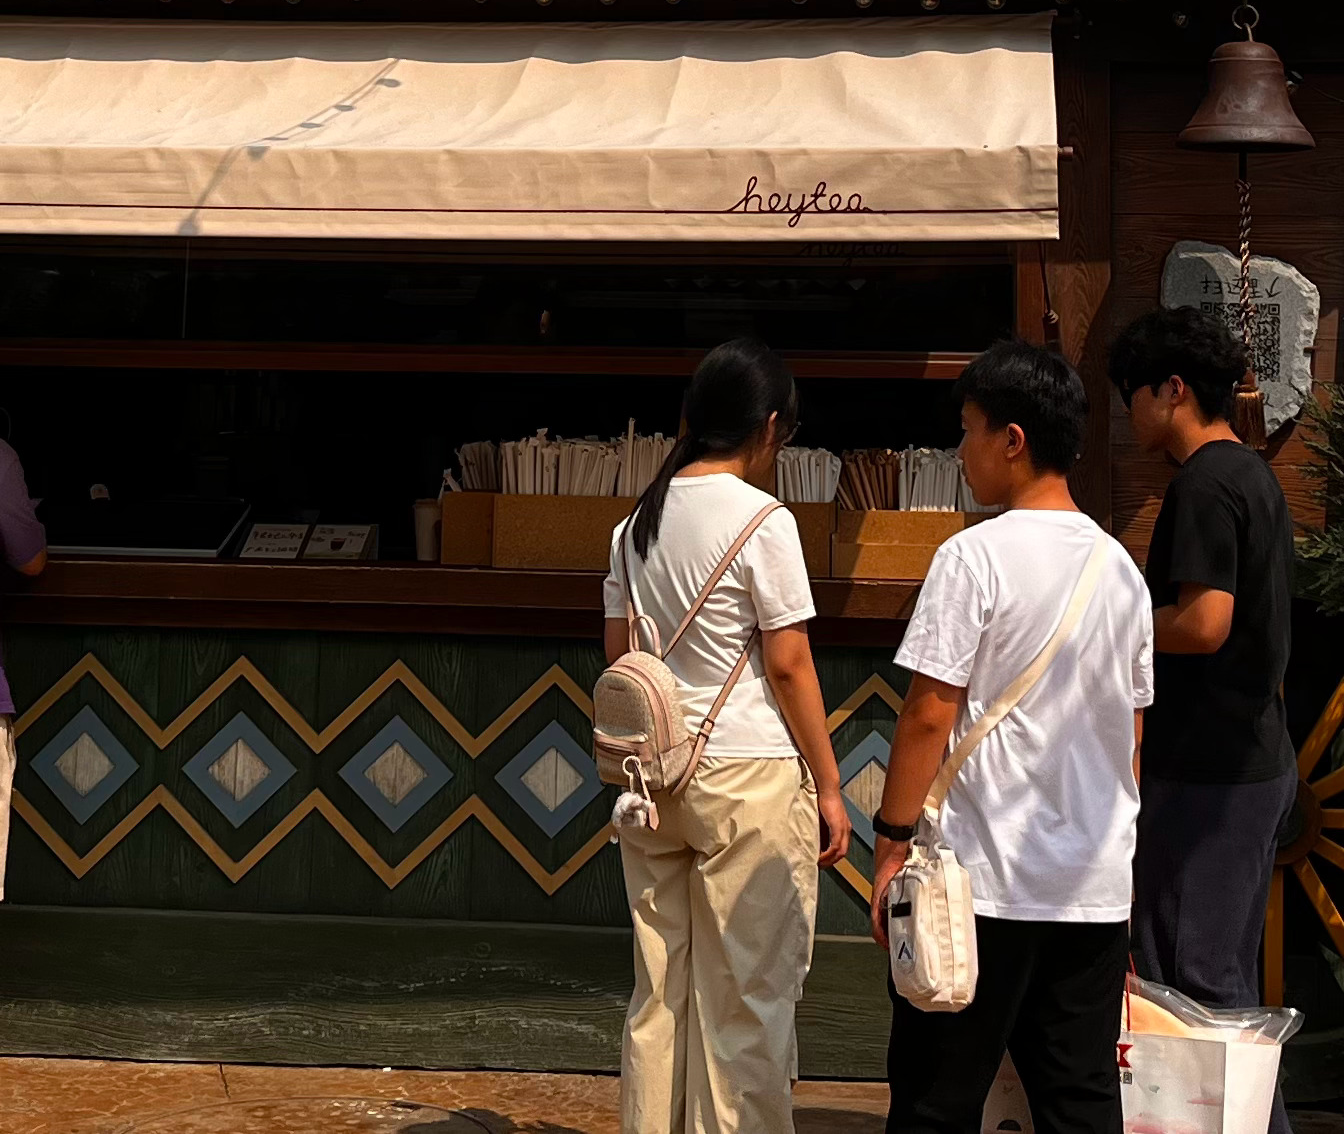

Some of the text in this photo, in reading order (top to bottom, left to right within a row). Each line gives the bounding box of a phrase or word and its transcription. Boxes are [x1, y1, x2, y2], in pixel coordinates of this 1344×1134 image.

[724, 175, 874, 228] heytea
[1199, 273, 1264, 299] 扫这里
